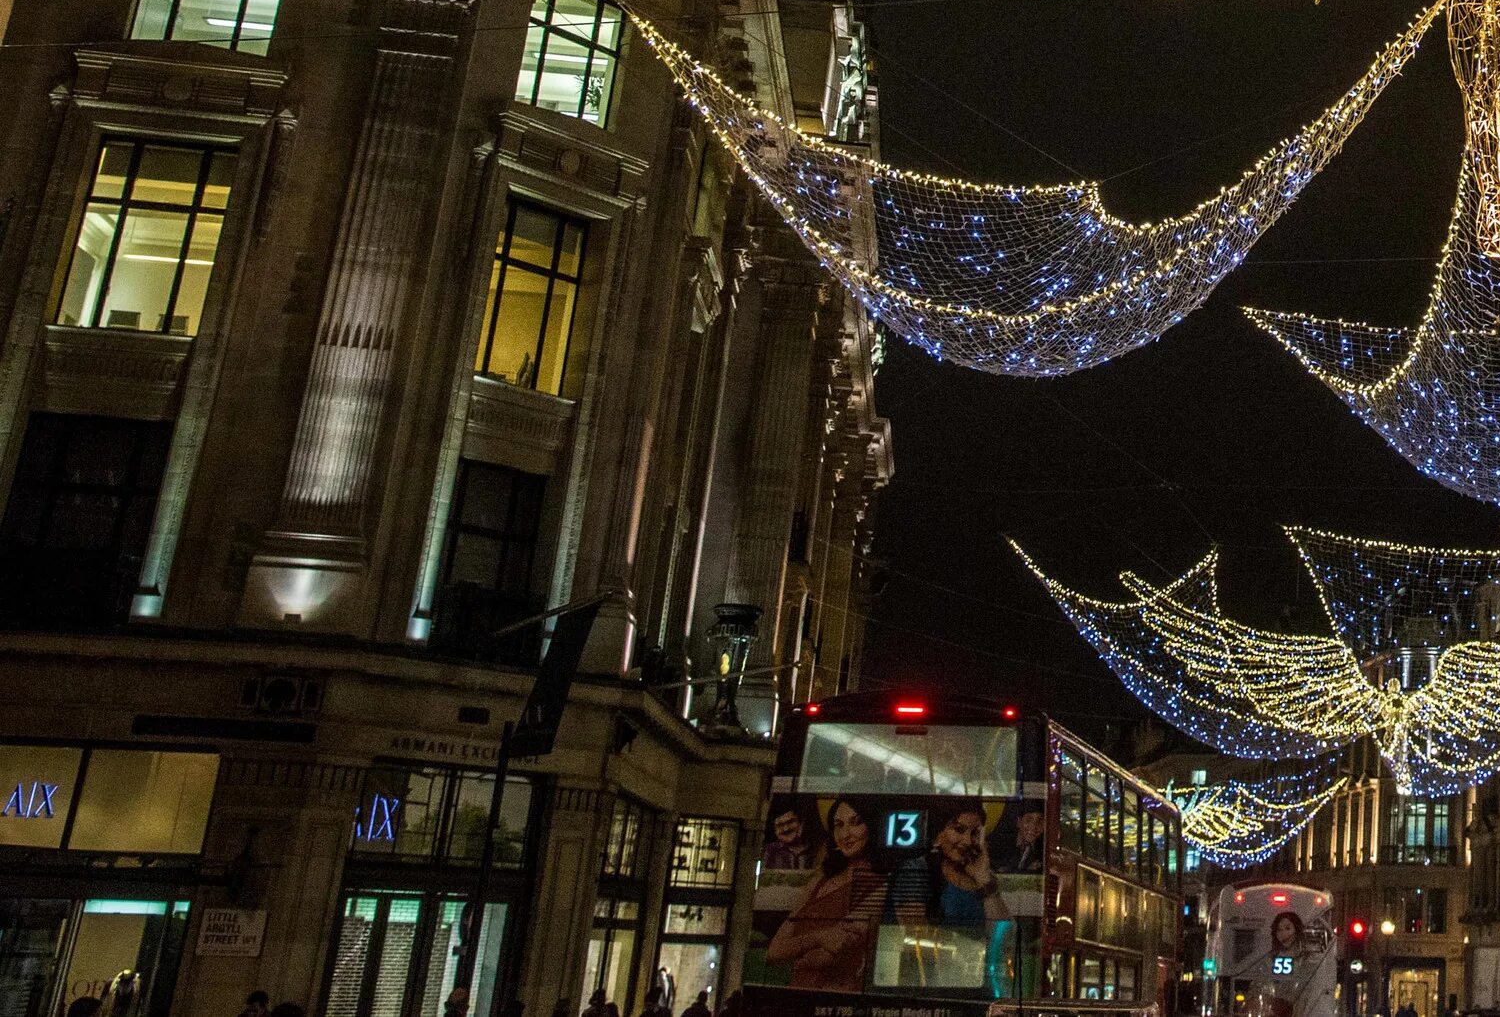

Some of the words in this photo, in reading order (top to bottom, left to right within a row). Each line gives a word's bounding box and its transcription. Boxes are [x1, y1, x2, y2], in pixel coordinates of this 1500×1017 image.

[391, 737, 455, 756] ARMANI
[886, 813, 919, 847] 13
[207, 912, 238, 923] LITTLE
[203, 934, 239, 944] STREET
[1273, 957, 1293, 974] 55
